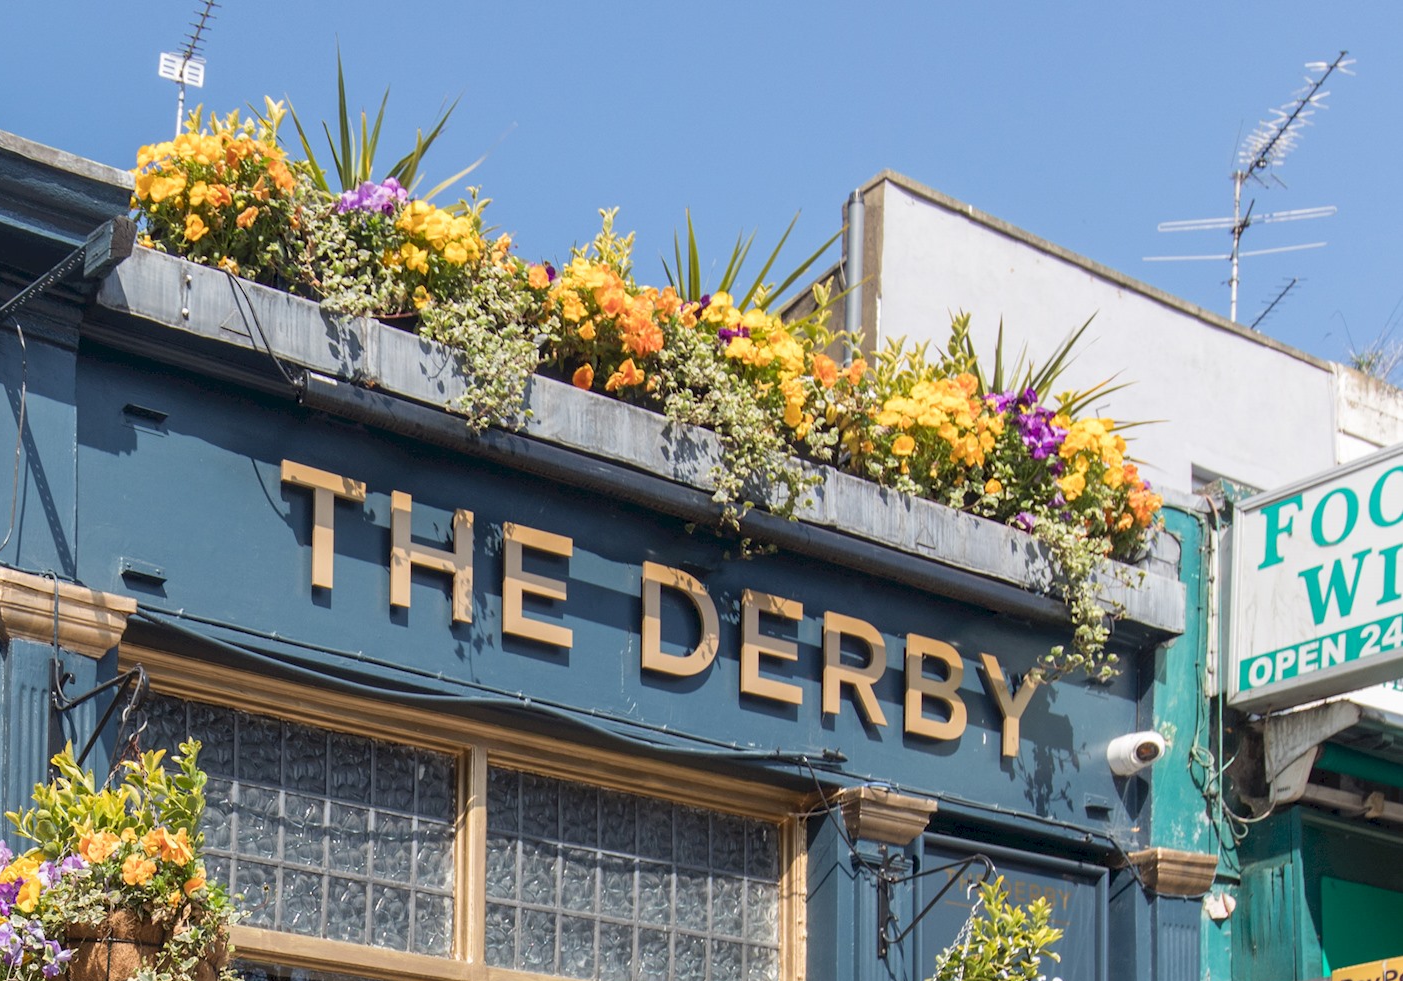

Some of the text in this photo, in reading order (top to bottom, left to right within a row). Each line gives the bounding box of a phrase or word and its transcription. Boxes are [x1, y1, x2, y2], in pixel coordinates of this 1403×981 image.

[280, 459, 1042, 758] THE DERBY
[1248, 633, 1346, 688] OPEN
